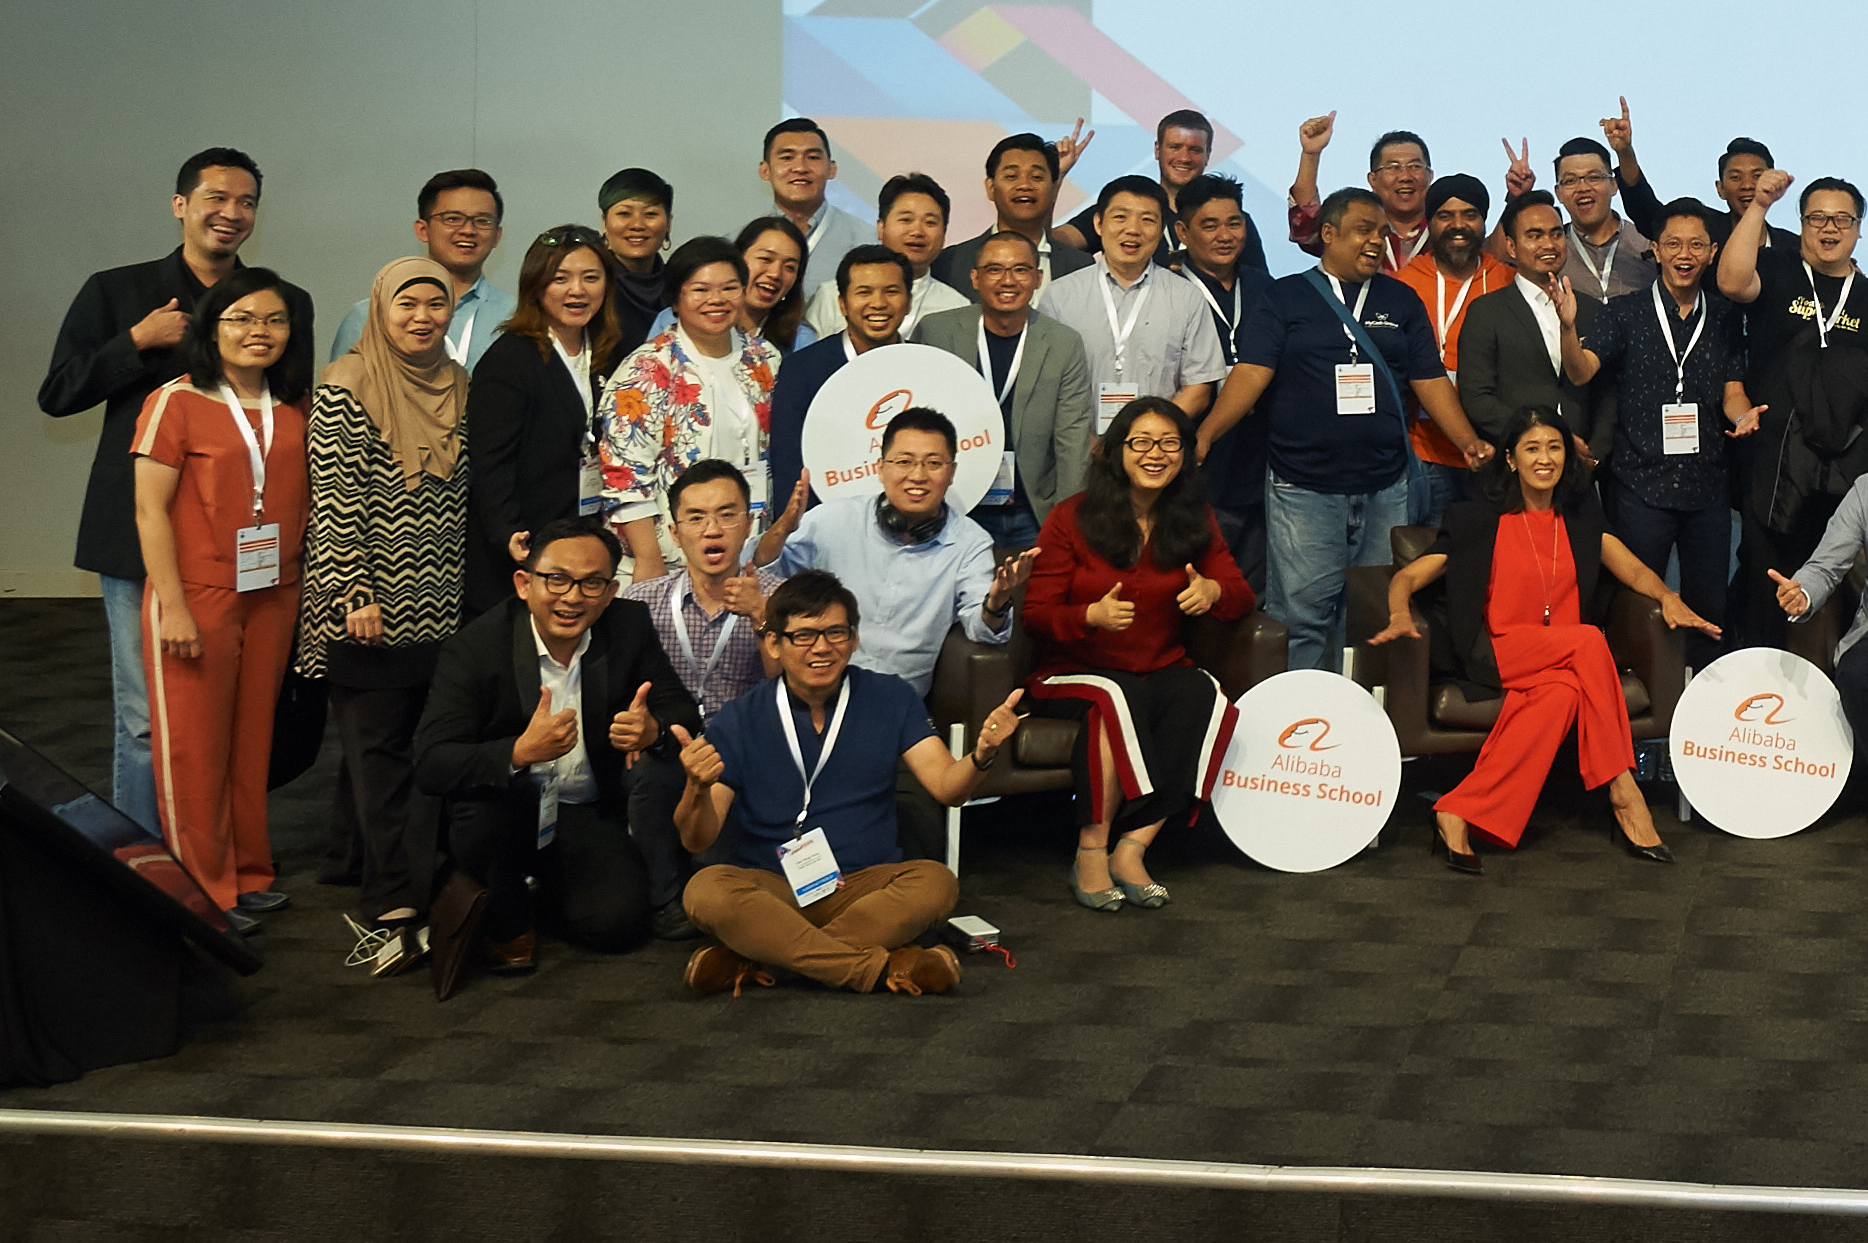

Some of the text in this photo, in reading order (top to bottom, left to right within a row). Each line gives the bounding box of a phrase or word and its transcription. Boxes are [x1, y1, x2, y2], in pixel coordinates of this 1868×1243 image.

[1728, 726, 1797, 751] Alibaba
[1271, 754, 1342, 778] Alibaba
[1682, 740, 1837, 779] Business School
[1222, 769, 1383, 807] Business School
